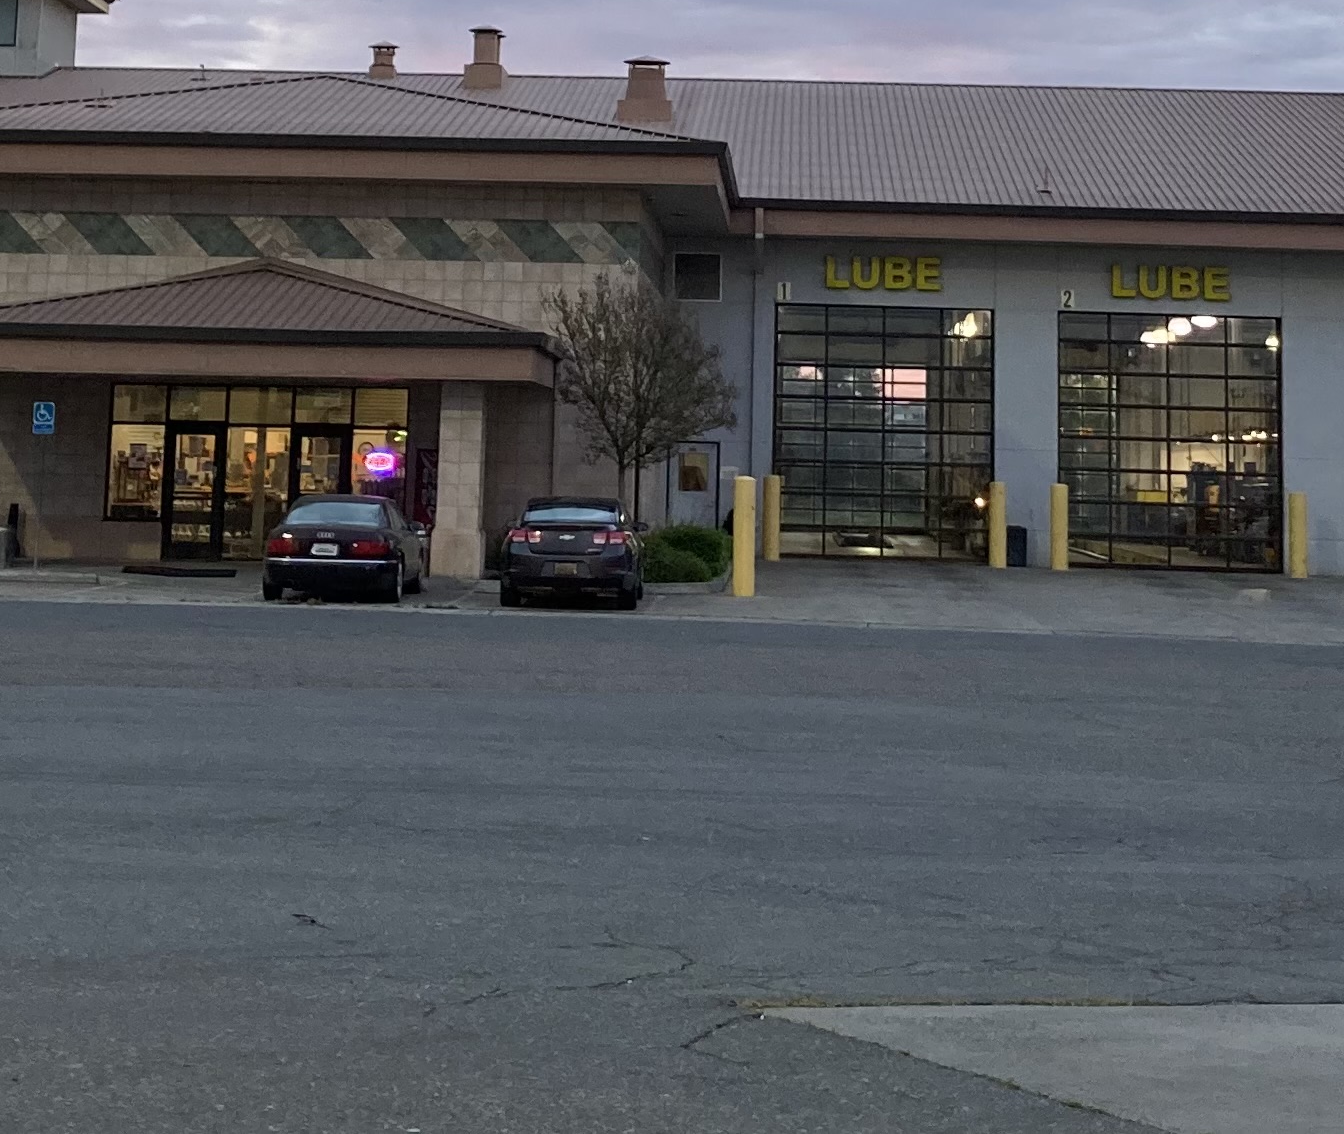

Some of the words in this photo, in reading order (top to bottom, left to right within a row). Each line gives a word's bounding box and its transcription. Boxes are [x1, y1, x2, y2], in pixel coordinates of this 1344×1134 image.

[824, 254, 943, 291] LUBE
[1111, 262, 1231, 301] LUBE
[1063, 290, 1072, 308] 2
